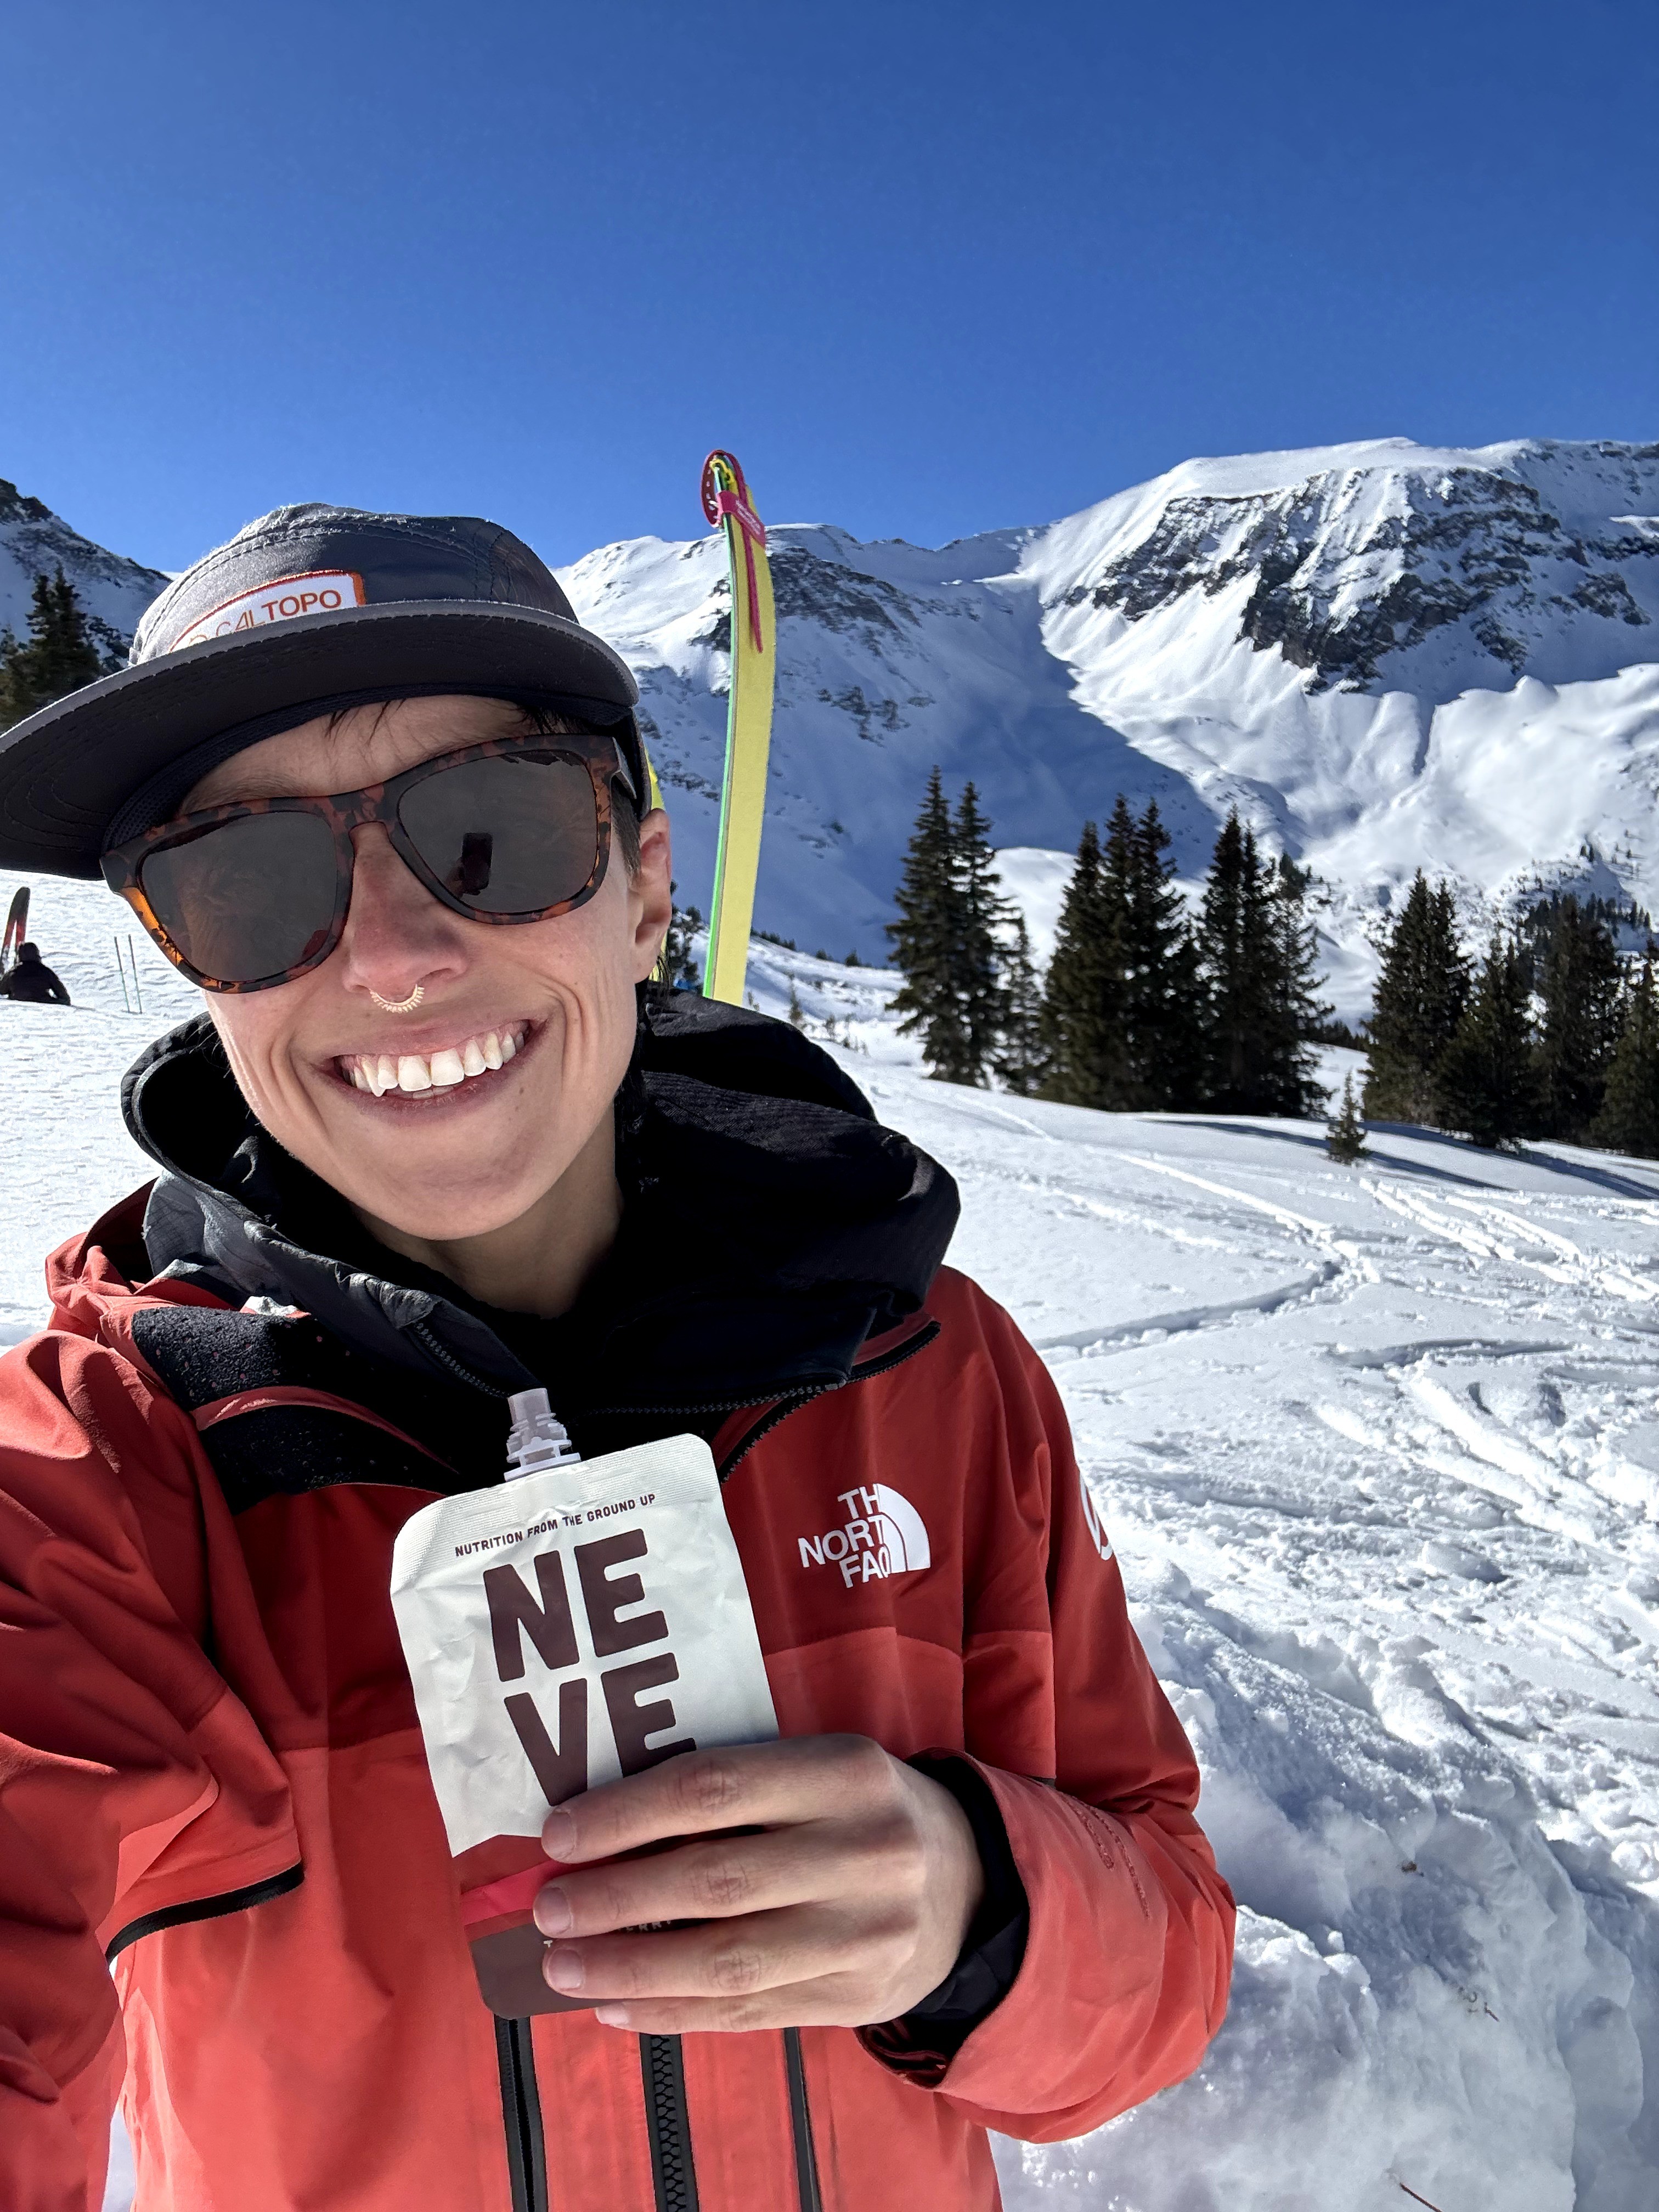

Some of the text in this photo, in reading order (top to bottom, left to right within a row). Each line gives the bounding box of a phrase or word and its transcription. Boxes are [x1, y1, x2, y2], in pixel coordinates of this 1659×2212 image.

[216, 590, 342, 636] CALTOPO
[455, 1493, 656, 1557] NUTRITION FROM THE GROUND UP
[838, 1483, 881, 1519] TH
[798, 1514, 884, 1568] NORT
[483, 1528, 669, 1682] NE
[504, 1652, 697, 1806] VE
